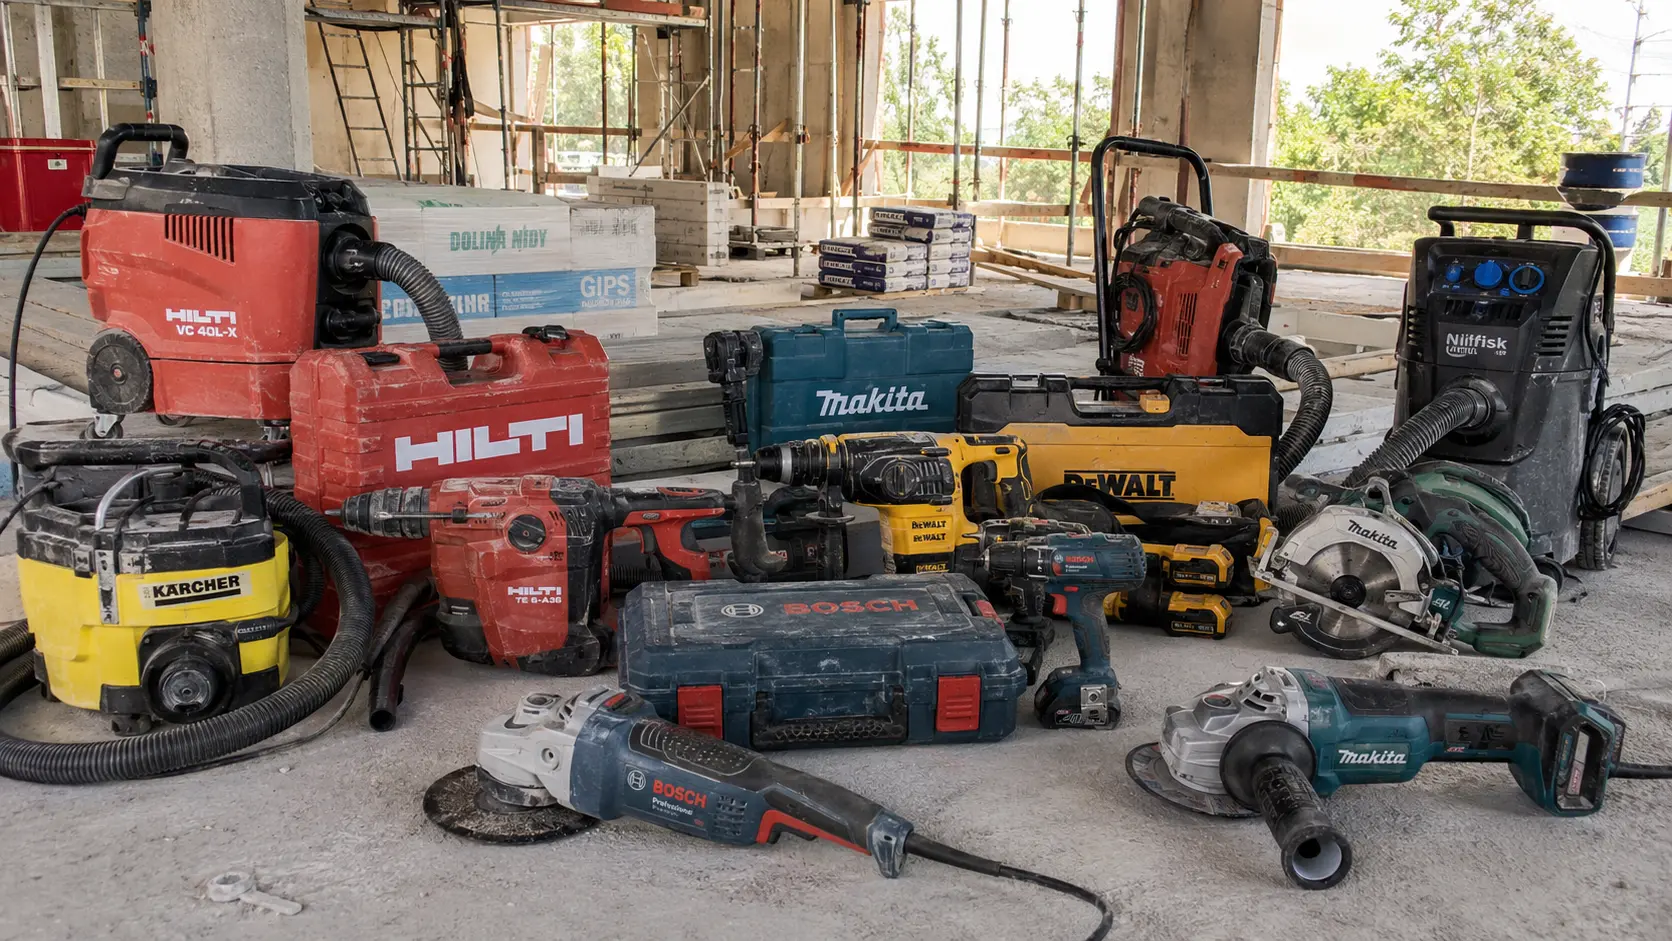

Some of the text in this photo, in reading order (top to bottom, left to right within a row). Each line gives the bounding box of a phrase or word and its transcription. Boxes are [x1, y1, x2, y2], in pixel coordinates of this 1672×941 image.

[450, 226, 506, 254] DOLINA
[580, 275, 630, 298] GIPS
[165, 308, 237, 325] HILTI
[176, 324, 238, 338] VC 40L-X
[816, 385, 929, 417] Makita
[395, 413, 584, 472] HILTI
[1348, 519, 1398, 550] Makita
[152, 575, 241, 599] KÄRCHER
[507, 586, 562, 596] HILTI
[515, 596, 529, 604] TE
[784, 600, 919, 616] BOSCH
[1338, 749, 1407, 764] Makita
[653, 779, 708, 809] BOSCH
